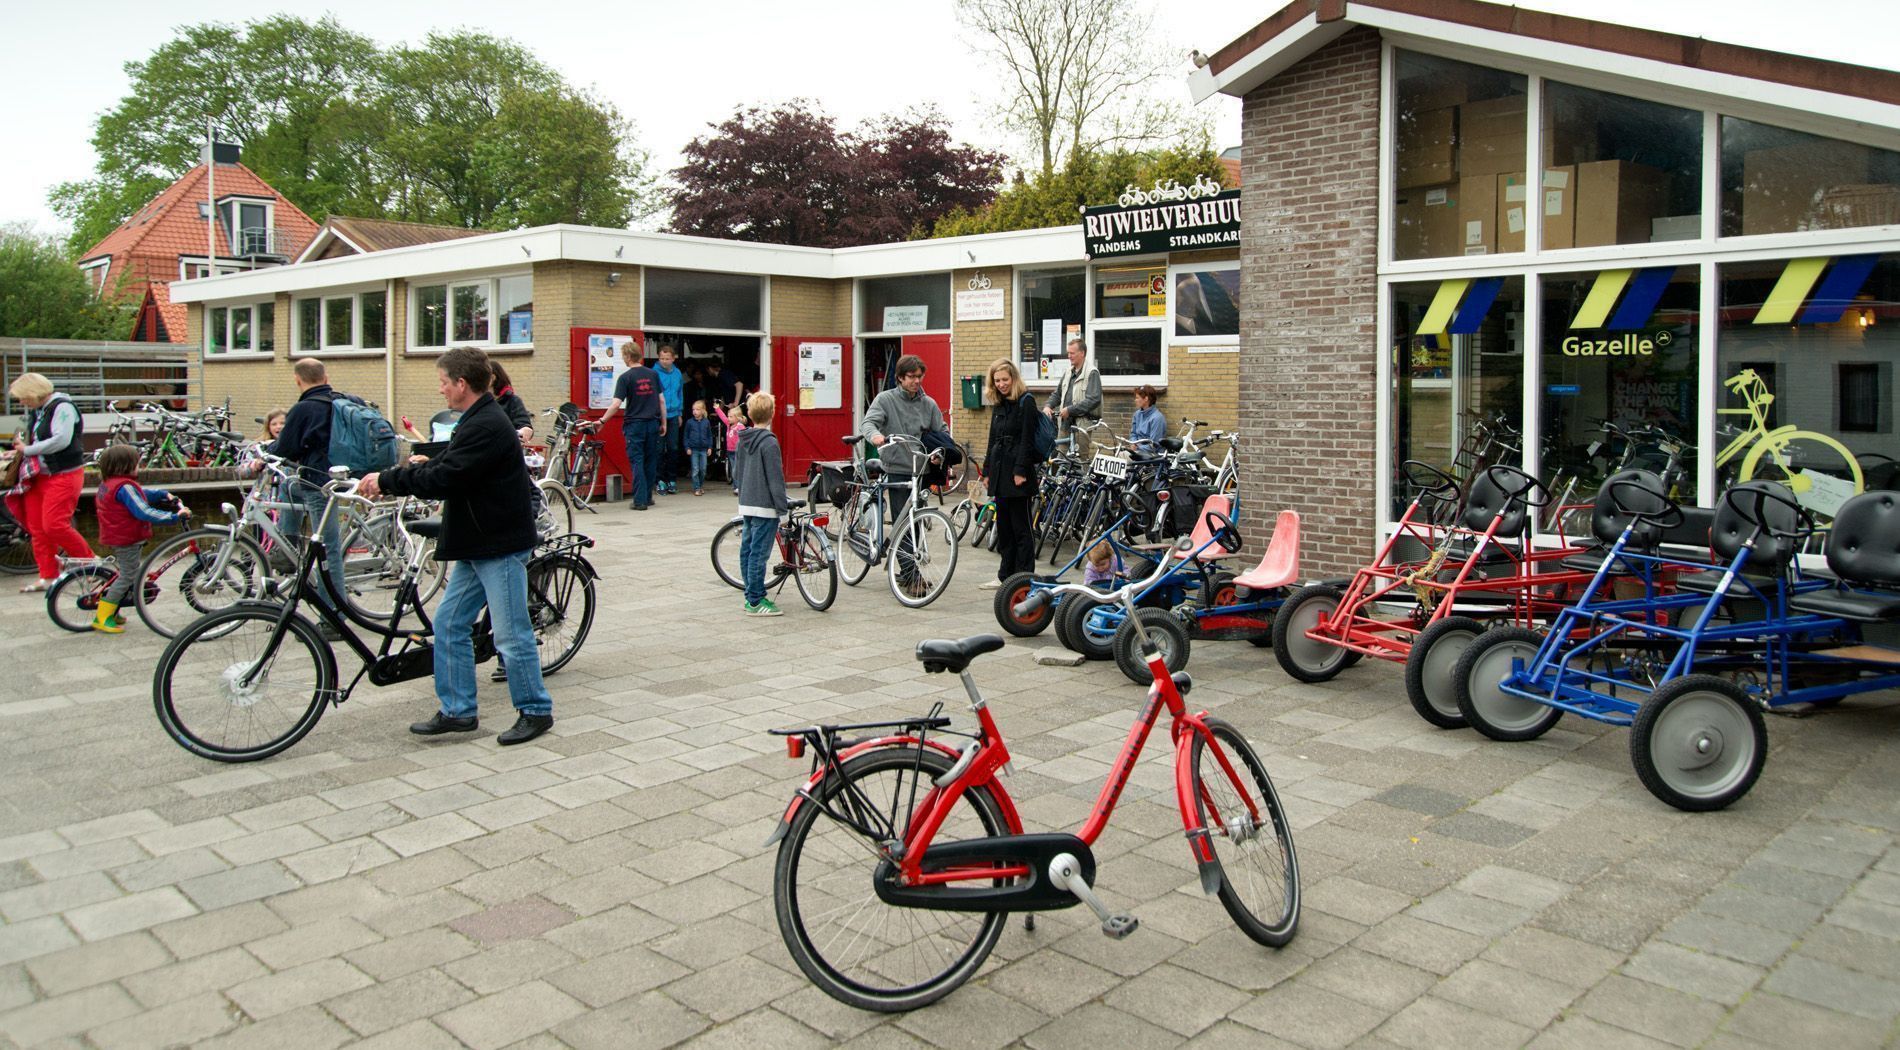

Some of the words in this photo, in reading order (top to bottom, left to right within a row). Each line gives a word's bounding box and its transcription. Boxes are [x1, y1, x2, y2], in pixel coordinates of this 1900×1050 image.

[1093, 240, 1141, 254] TANDEMS
[1562, 333, 1654, 356] Gazelle
[971, 383, 976, 394] 1
[1615, 382, 1677, 395] CHANGE
[1615, 395, 1645, 407] THE
[1647, 395, 1678, 407] WAY
[1095, 457, 1104, 472] TE
[1104, 460, 1126, 476] KOOP
